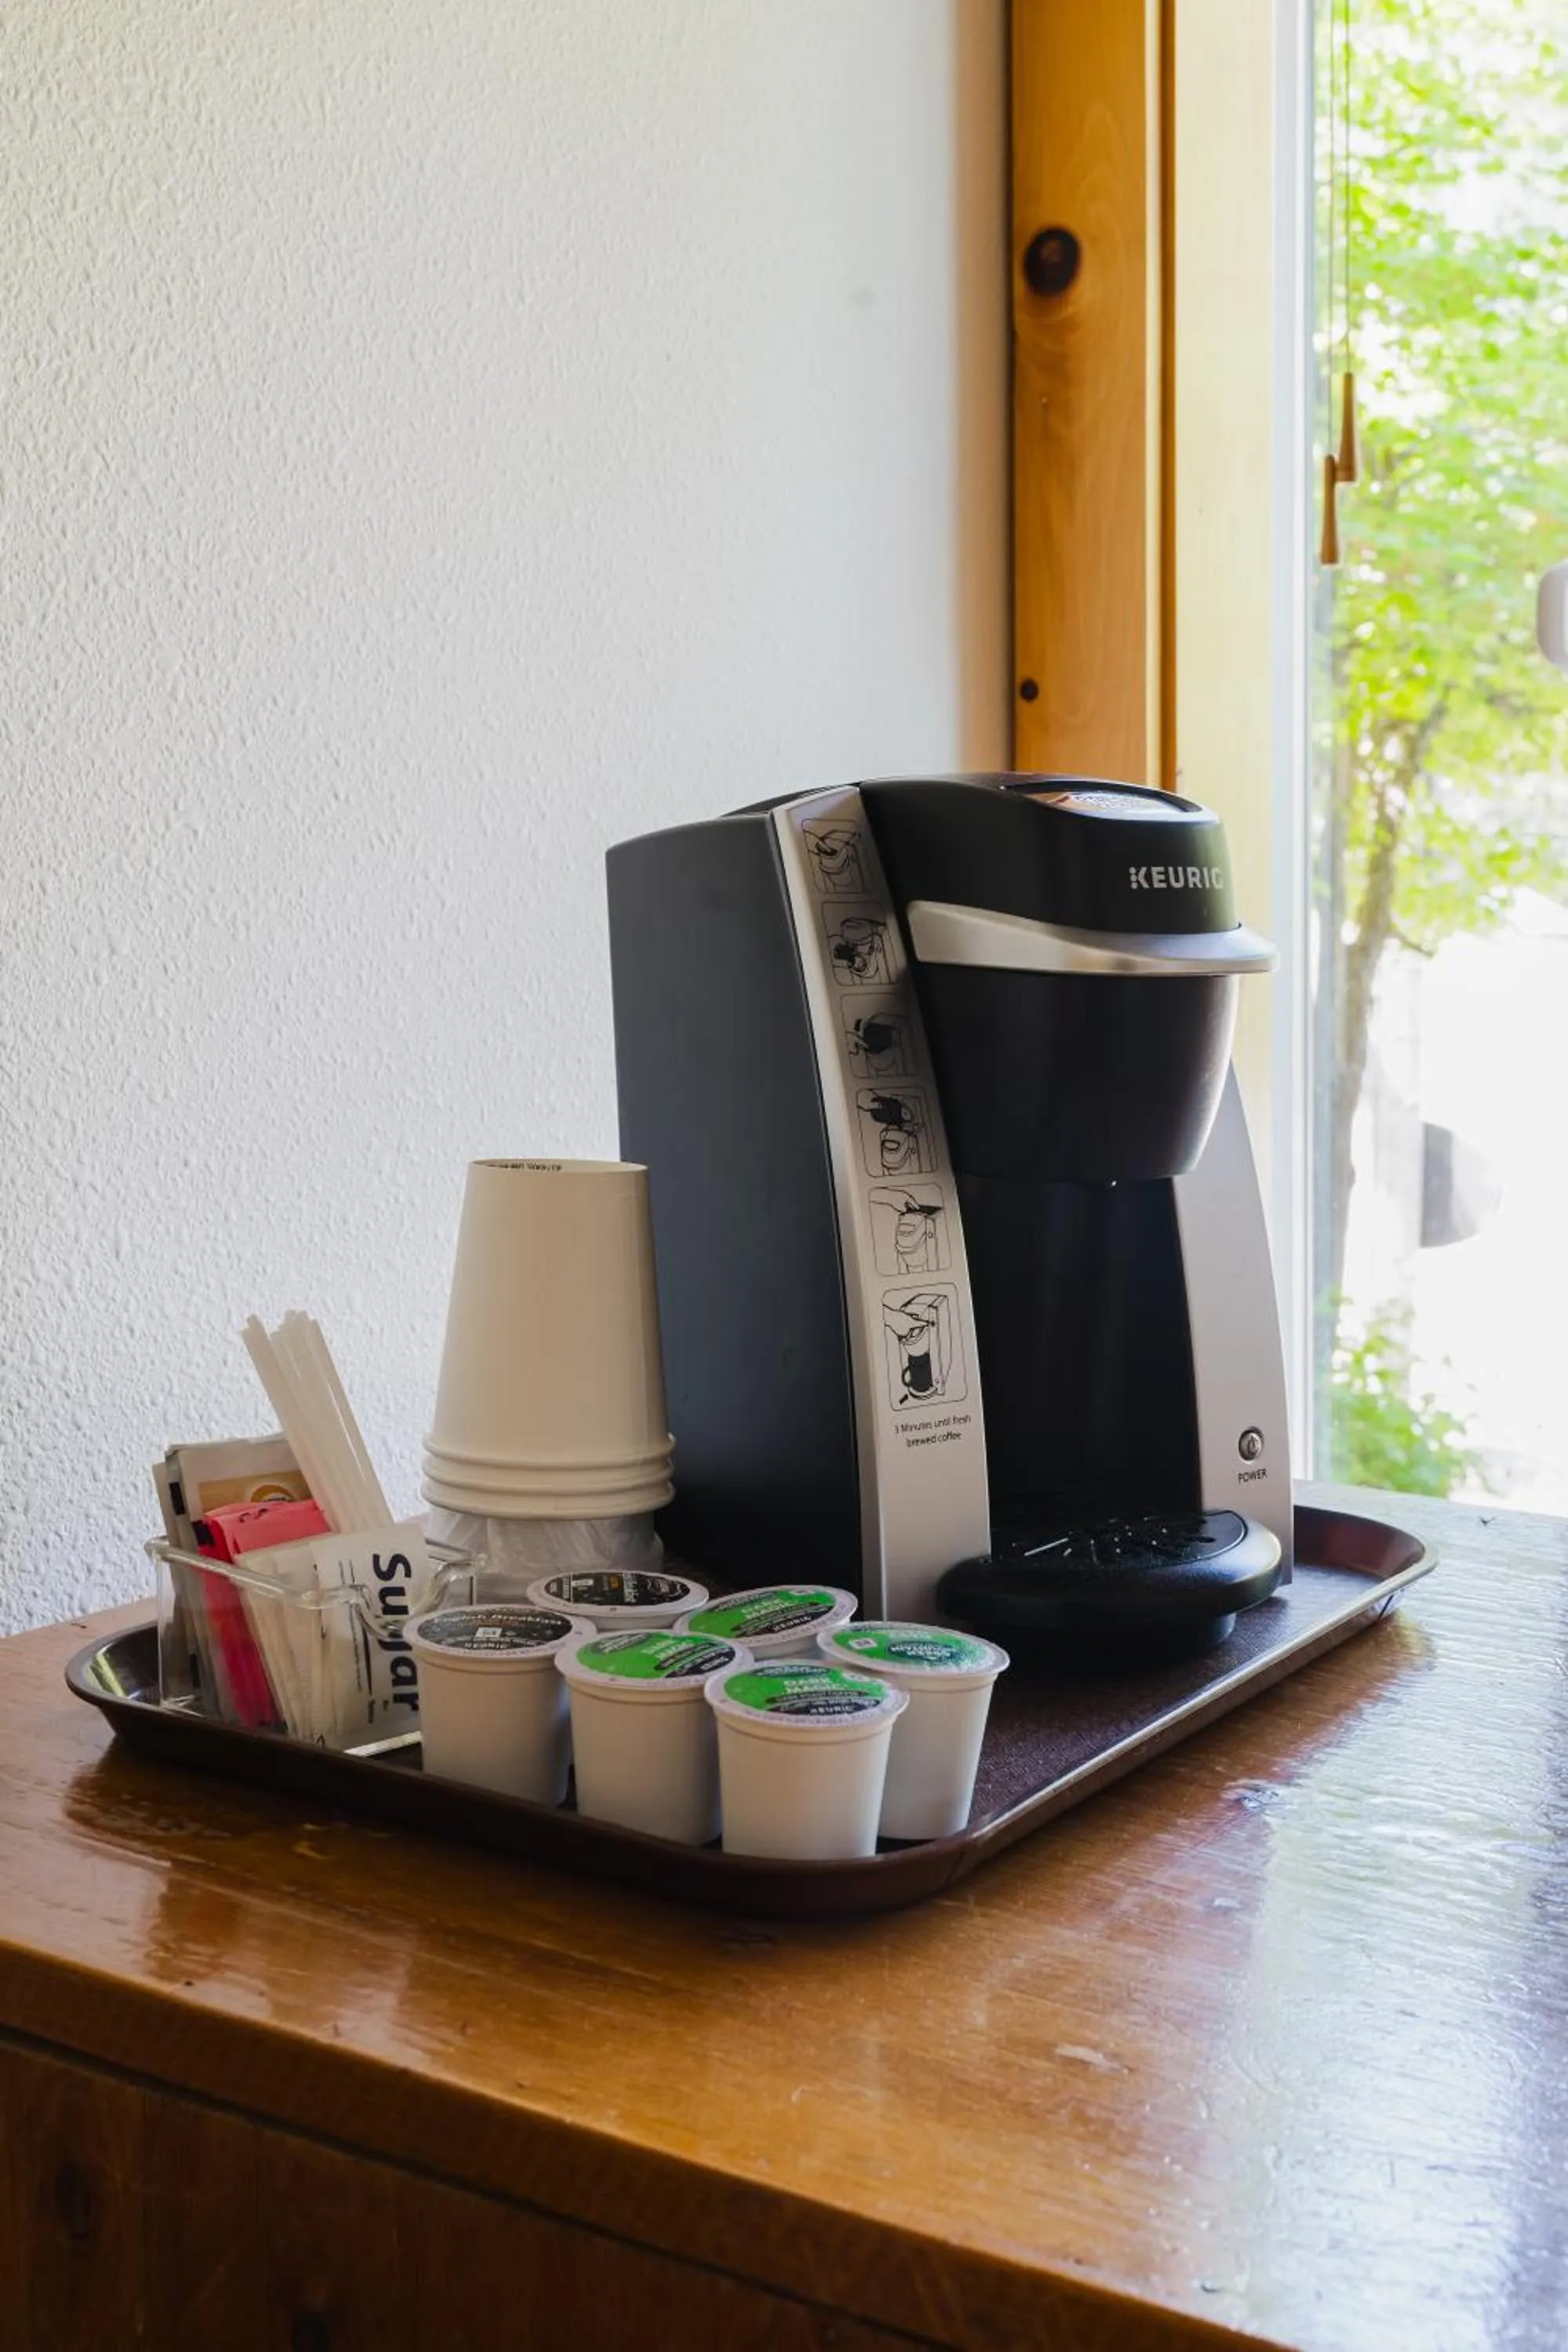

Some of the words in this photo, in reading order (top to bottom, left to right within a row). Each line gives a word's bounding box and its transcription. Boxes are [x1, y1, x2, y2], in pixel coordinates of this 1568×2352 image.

[1129, 866, 1225, 889] KEURIG
[906, 1433, 937, 1447] brewed
[938, 1431, 961, 1443] coffee
[1238, 1468, 1267, 1483] POWER
